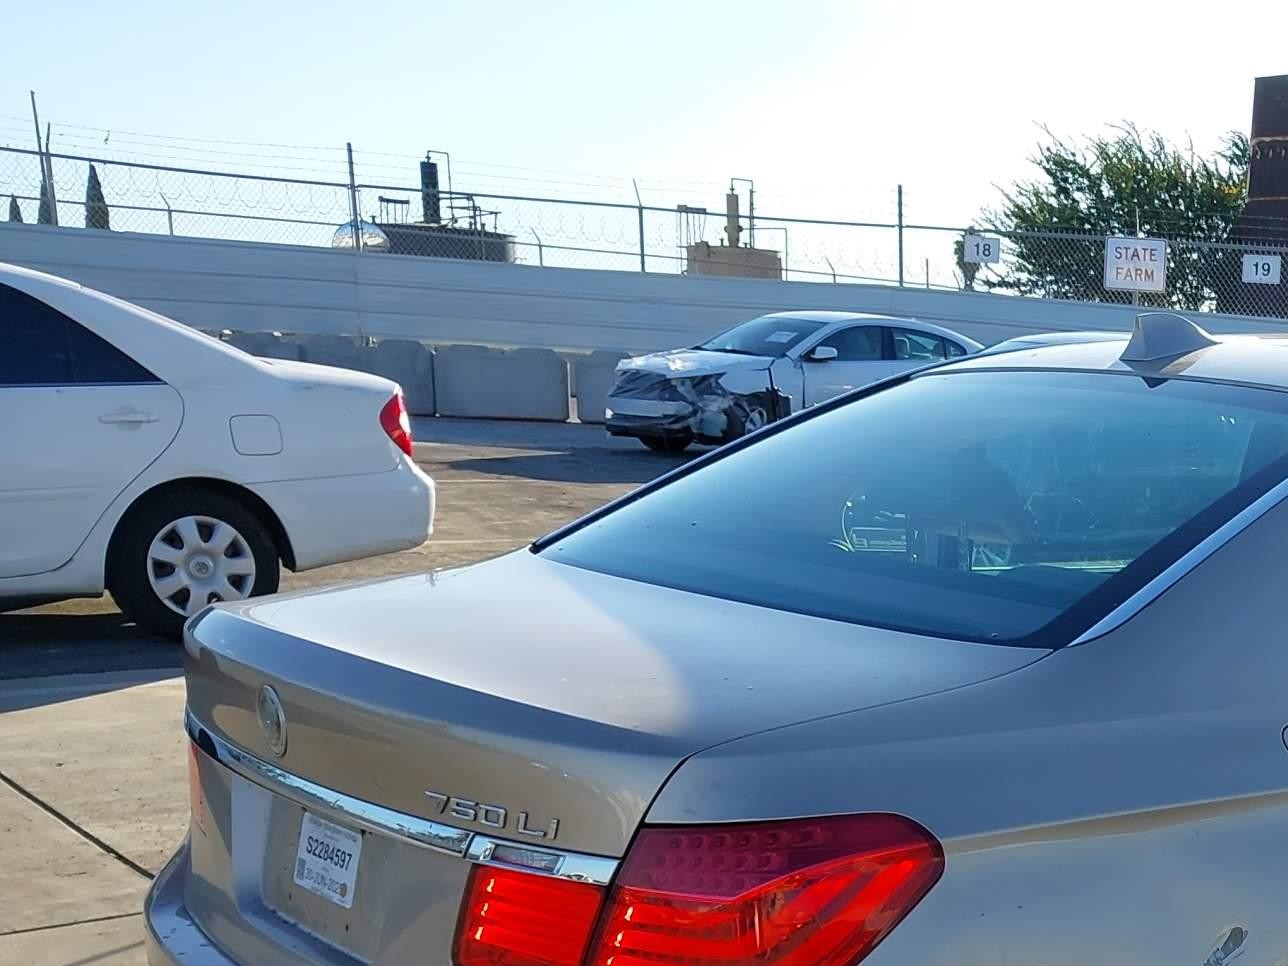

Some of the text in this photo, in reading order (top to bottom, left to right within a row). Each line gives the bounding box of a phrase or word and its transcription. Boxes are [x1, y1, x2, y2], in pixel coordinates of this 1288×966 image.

[973, 242, 992, 257] 18
[1114, 246, 1159, 263] STATE
[1115, 266, 1155, 282] FARM
[1252, 261, 1272, 278] 19
[423, 790, 507, 829] 750
[305, 835, 353, 871] S2284597
